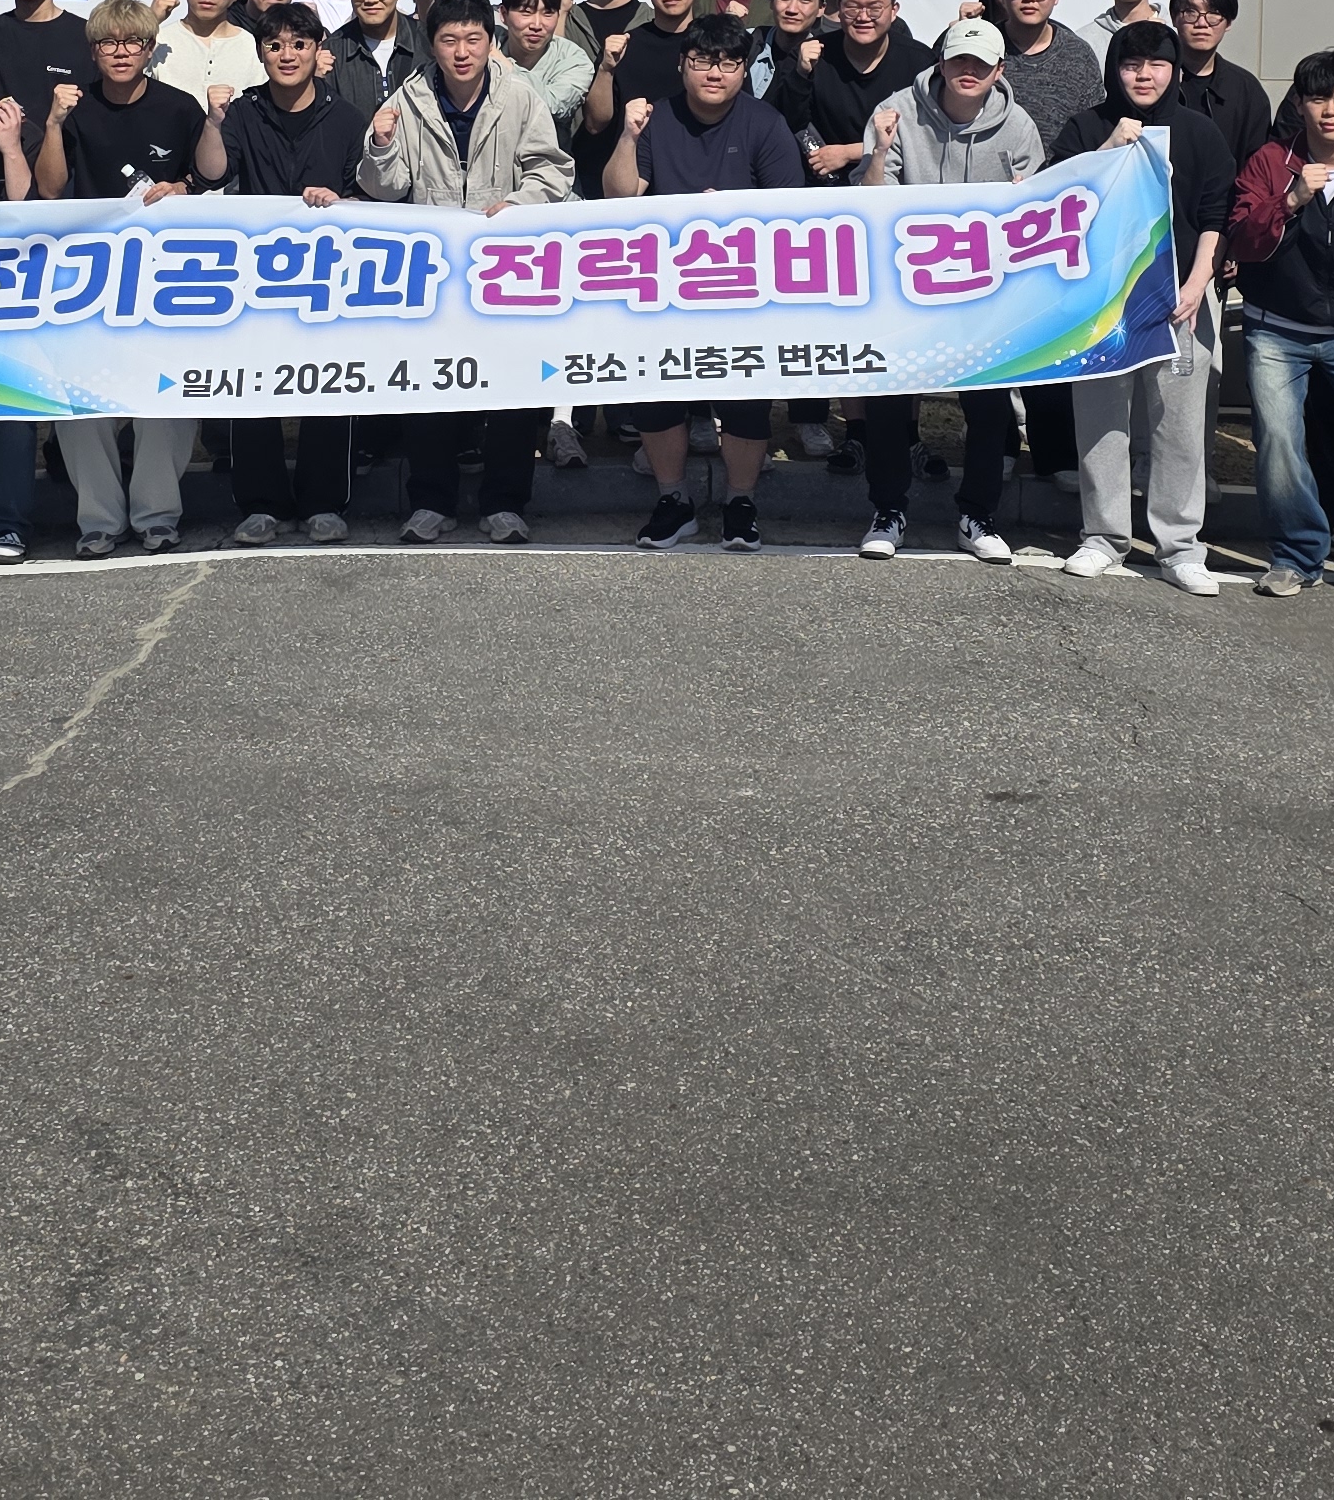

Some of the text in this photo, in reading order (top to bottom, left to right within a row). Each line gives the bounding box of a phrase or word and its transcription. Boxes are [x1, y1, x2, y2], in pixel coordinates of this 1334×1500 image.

[478, 223, 857, 307] 전력설비
[906, 194, 1088, 296] 견학
[182, 368, 245, 398] 일시
[273, 361, 375, 396] 2025.
[387, 359, 420, 392] 4.
[432, 356, 489, 391] 30.
[564, 353, 628, 385] 장소
[658, 345, 766, 381] 신충주
[777, 343, 888, 377] 변전소
